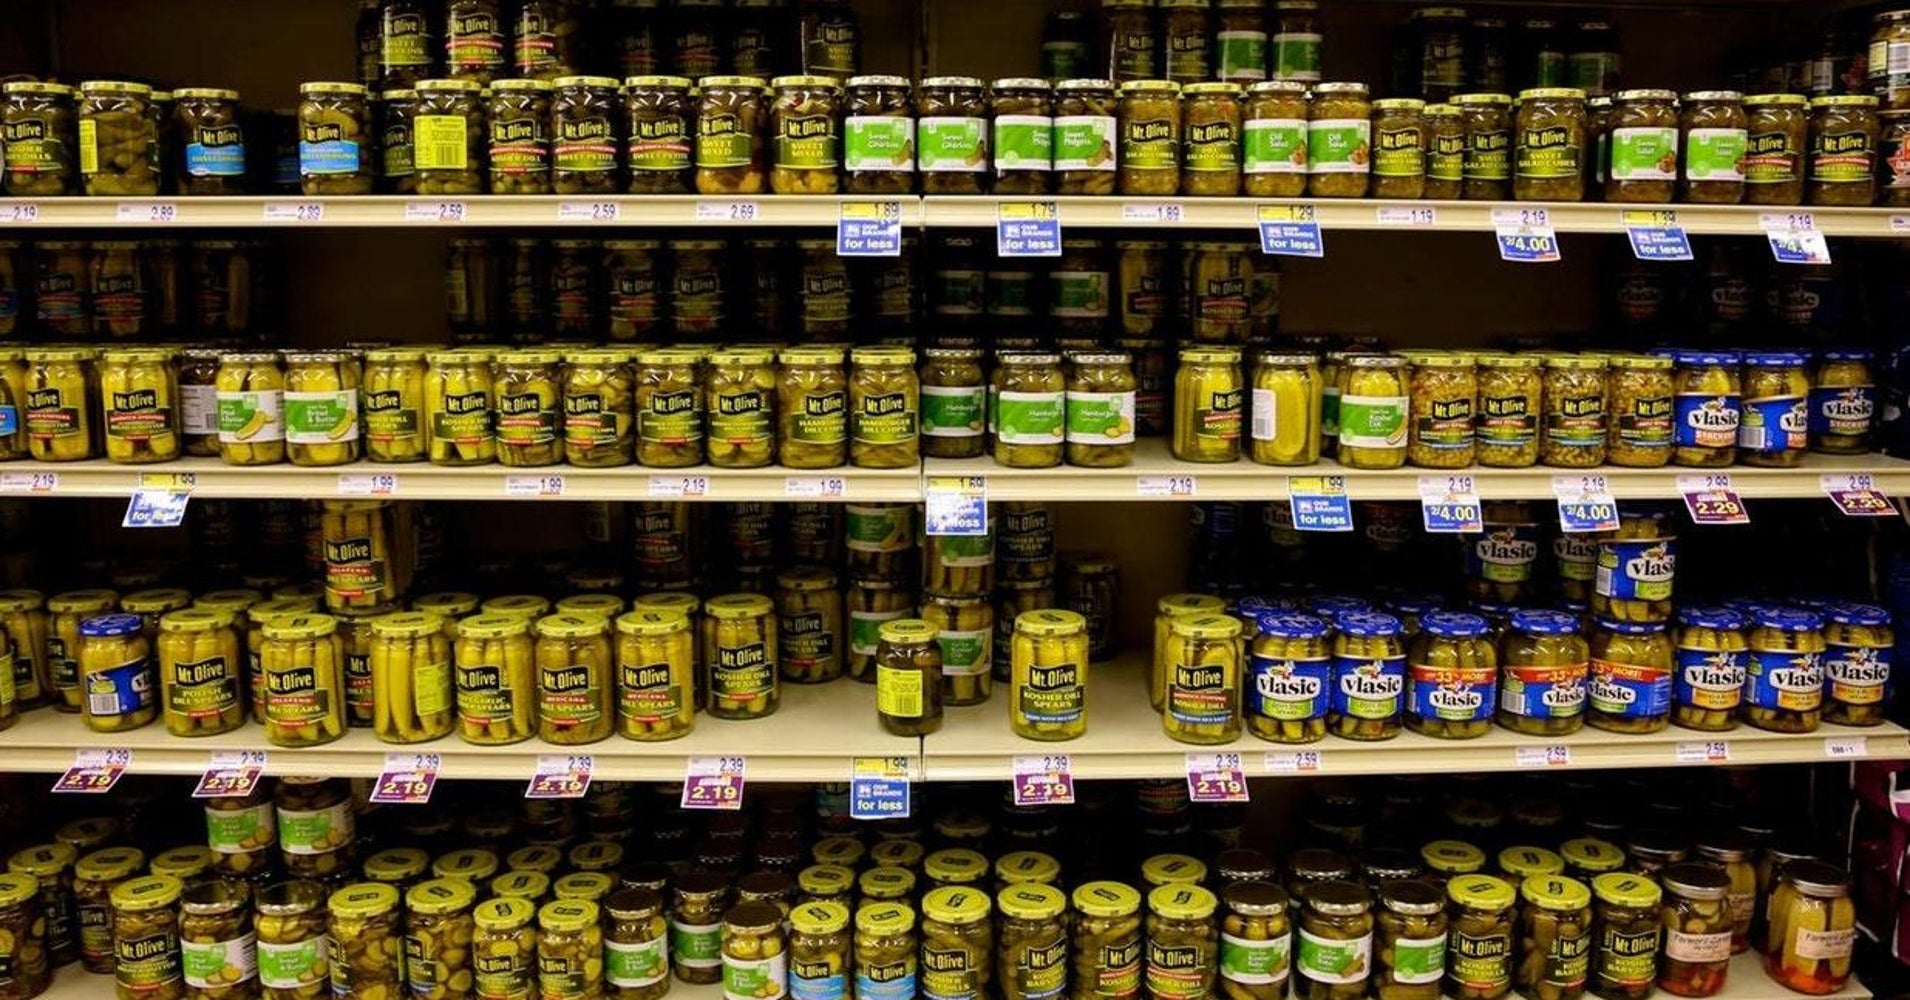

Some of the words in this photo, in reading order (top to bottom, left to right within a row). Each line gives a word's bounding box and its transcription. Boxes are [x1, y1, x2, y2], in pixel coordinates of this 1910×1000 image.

[845, 236, 863, 250] for
[867, 235, 894, 250] less
[1006, 236, 1025, 250] for
[1031, 235, 1055, 250] less
[1269, 238, 1288, 251] for
[1300, 514, 1318, 525] for
[1322, 514, 1347, 527] less
[736, 646, 763, 667] Olive
[194, 662, 223, 682] Olive
[283, 671, 313, 692] Olive
[471, 668, 498, 691] Olive
[558, 669, 587, 689] Olive
[639, 668, 668, 687] Olive
[1047, 667, 1075, 688] Olive
[1192, 670, 1222, 690] Olive
[1689, 667, 1744, 688] vlasic
[1775, 671, 1823, 690] vlasi
[1828, 662, 1887, 684] vlasic
[1258, 678, 1317, 696] vlasic
[1345, 678, 1400, 696] vlasic
[1432, 691, 1482, 707] vlasic
[382, 781, 429, 795] 2.19
[691, 785, 739, 800] 2.19
[1197, 782, 1241, 795] 2.19
[857, 800, 876, 813] for
[880, 799, 903, 813] less
[137, 939, 166, 958] Olive
[1477, 938, 1505, 956] Olive
[1629, 936, 1658, 956] Olive
[1166, 950, 1195, 969] Olive
